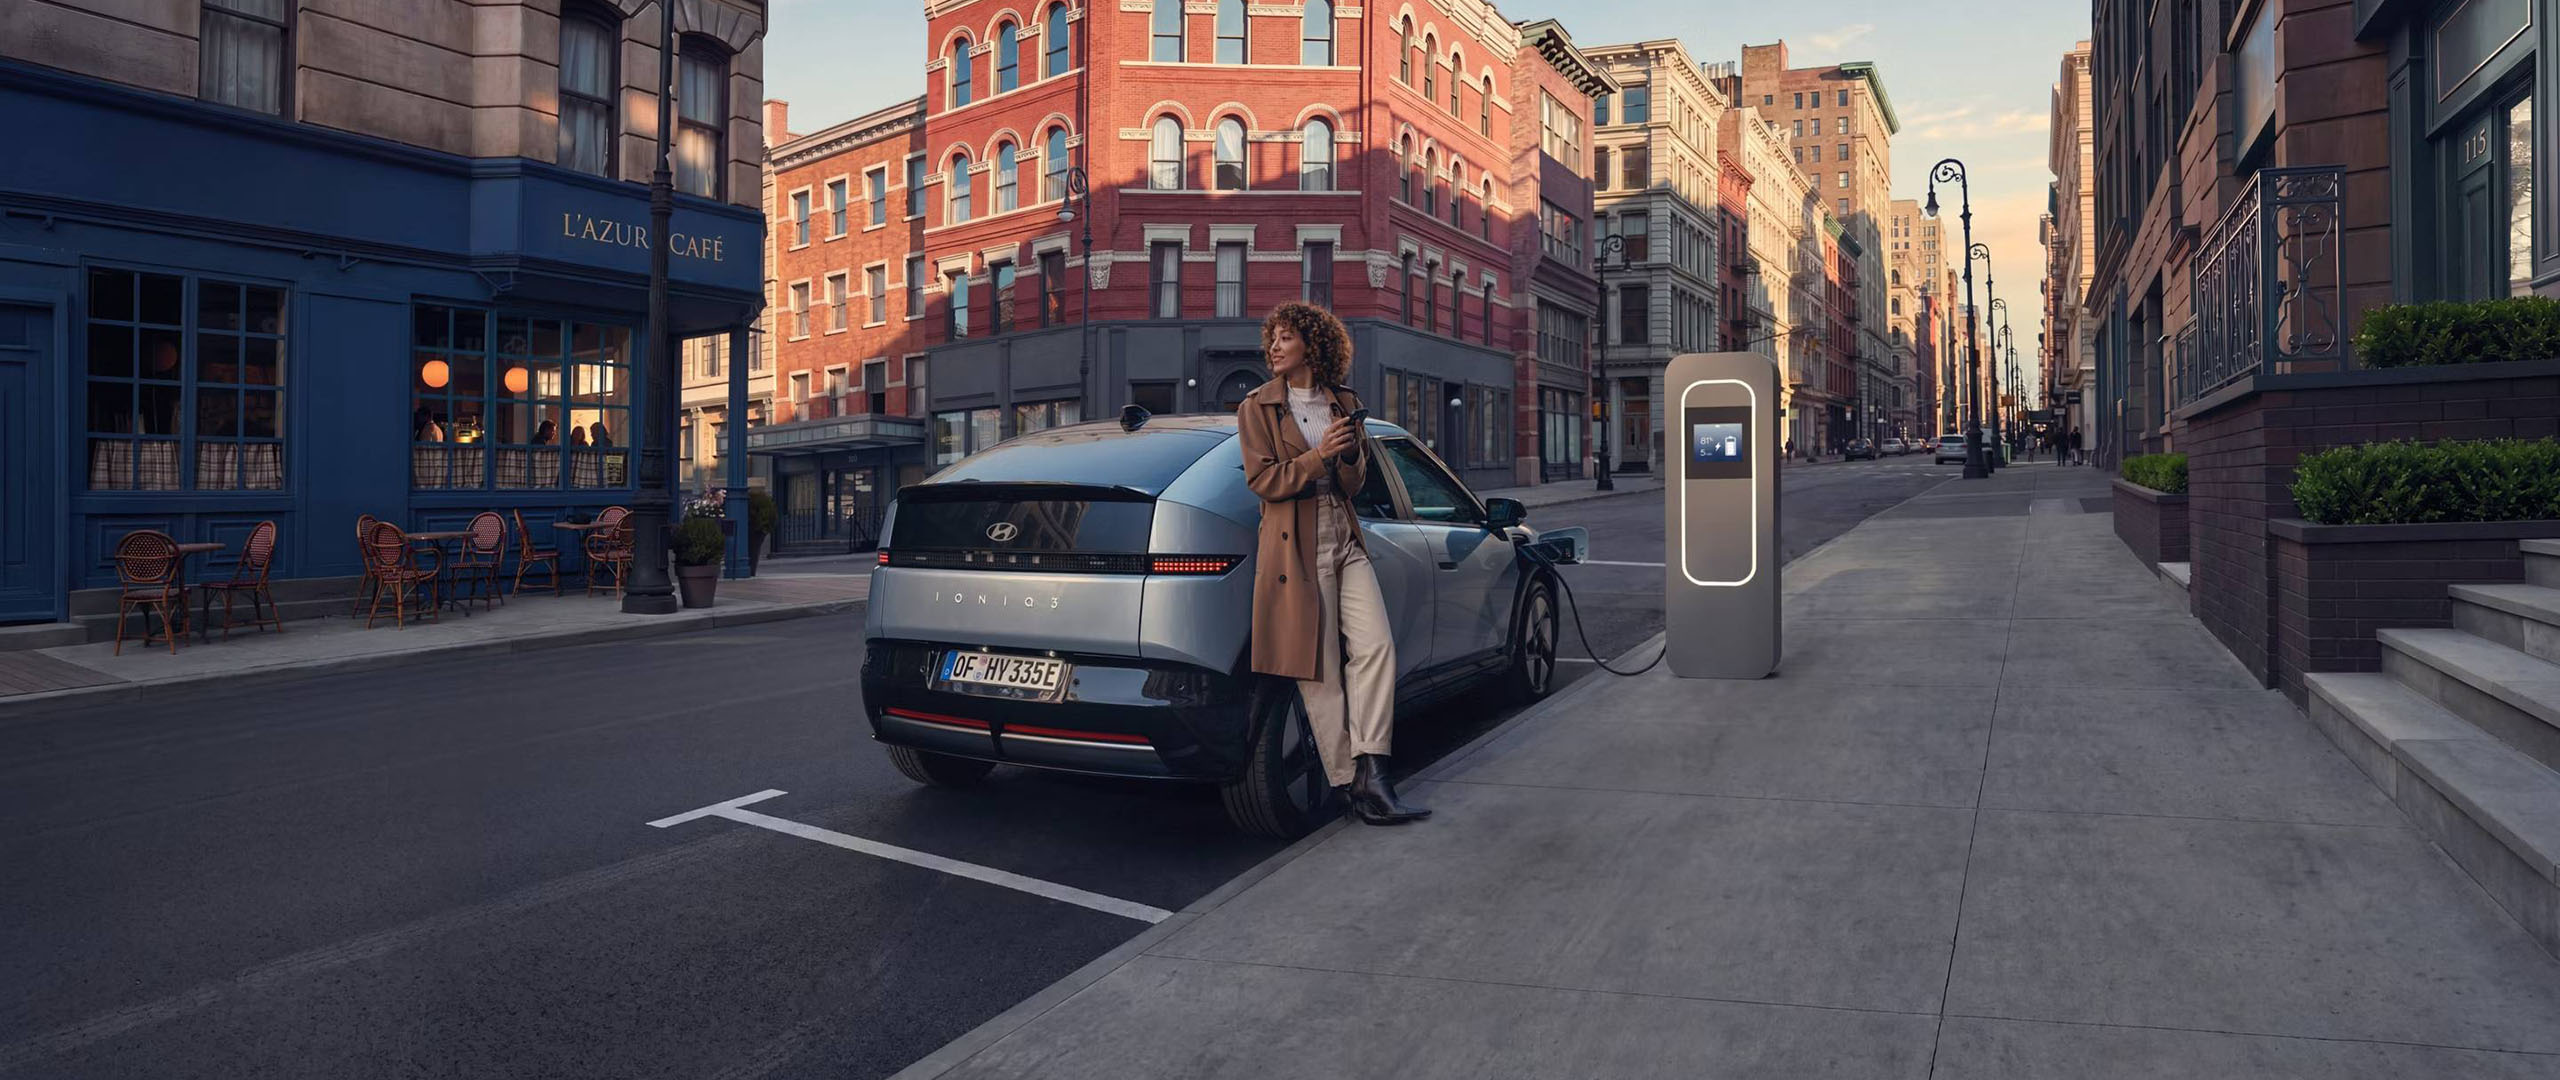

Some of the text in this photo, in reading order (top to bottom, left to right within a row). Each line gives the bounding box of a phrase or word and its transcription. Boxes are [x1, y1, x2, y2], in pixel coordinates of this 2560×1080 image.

[2464, 128, 2487, 164] 115
[562, 213, 724, 262] L'AZUR CAFÉ
[953, 655, 978, 678] OF
